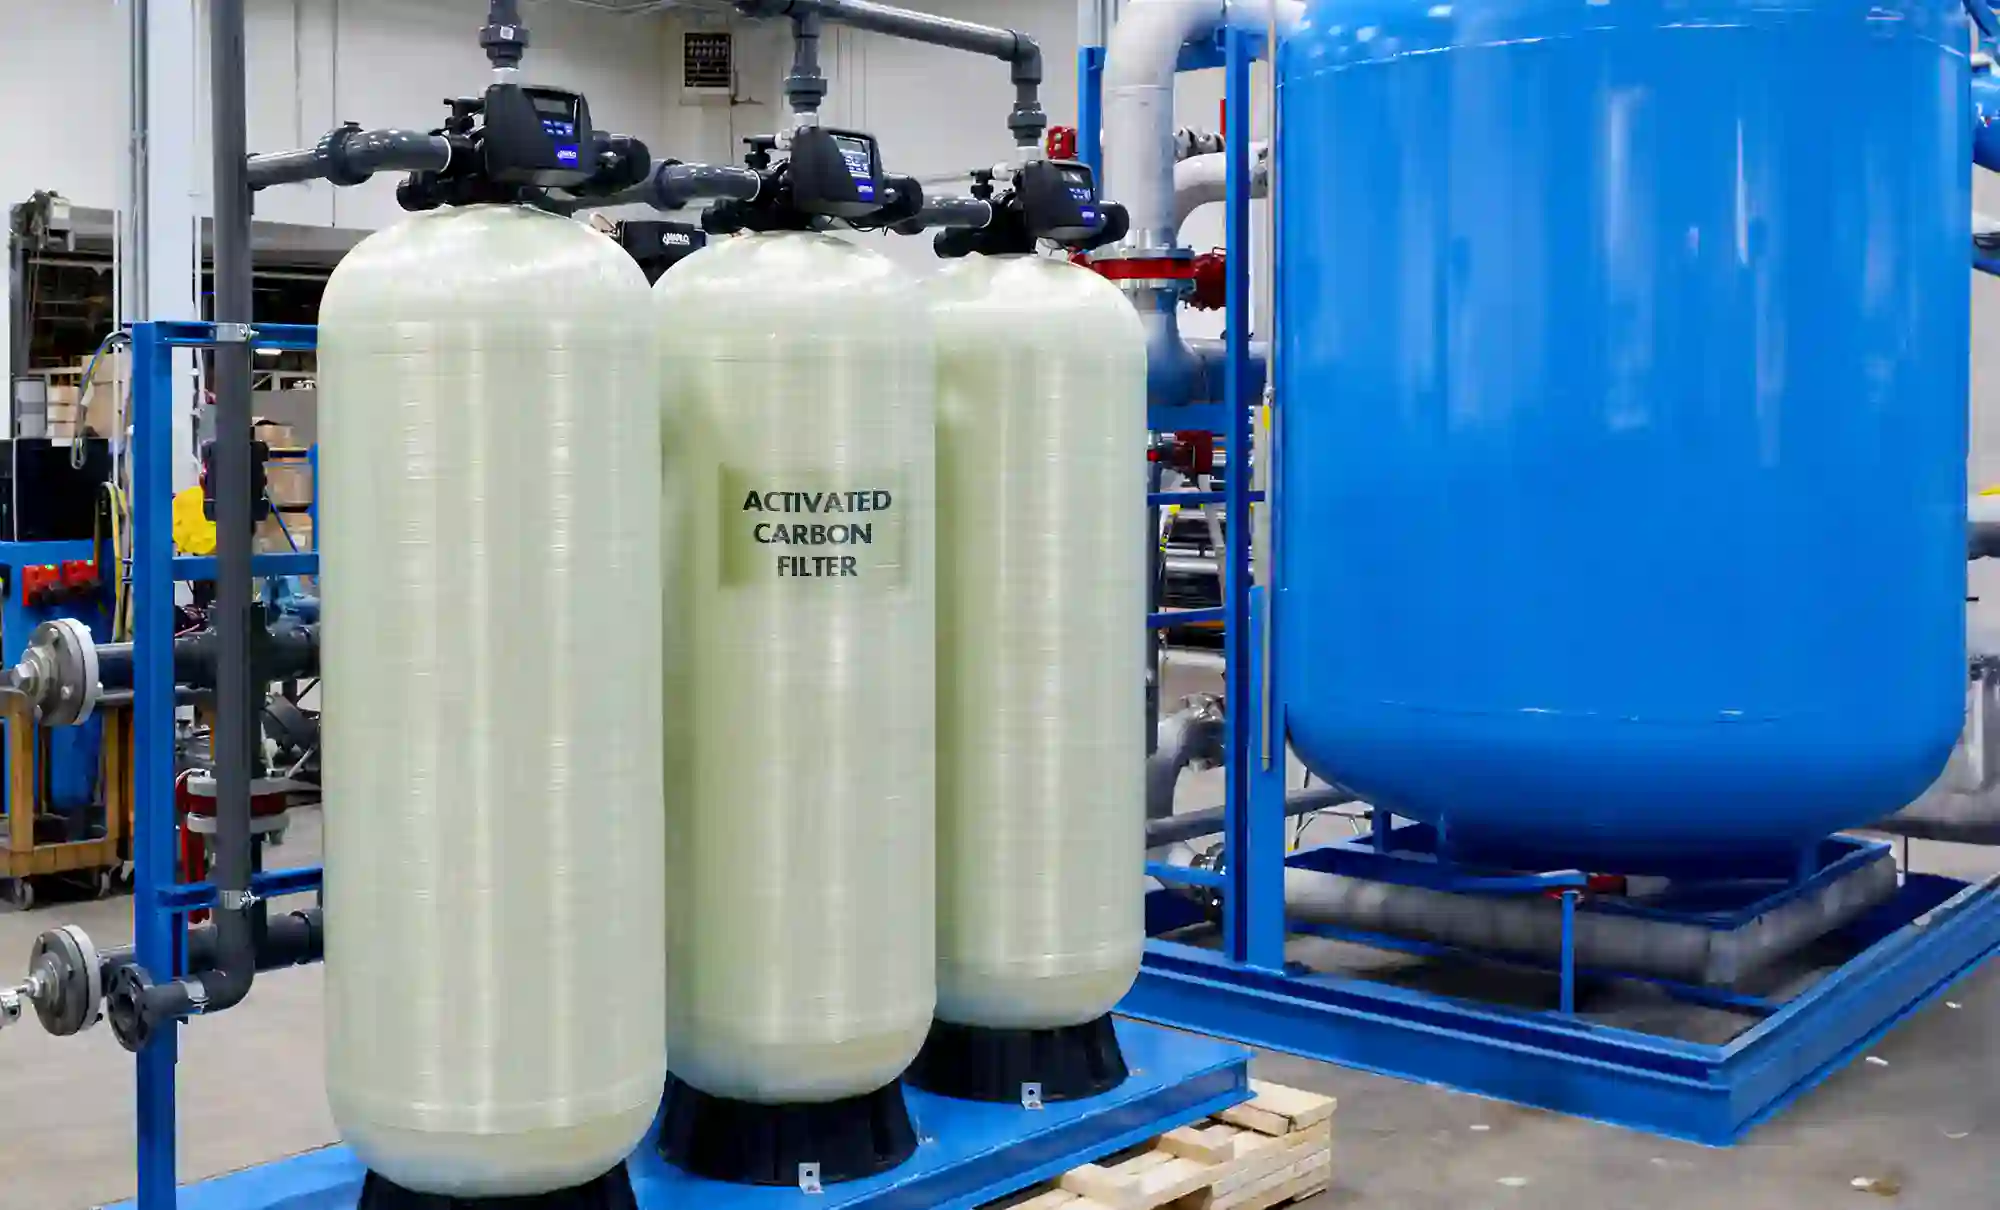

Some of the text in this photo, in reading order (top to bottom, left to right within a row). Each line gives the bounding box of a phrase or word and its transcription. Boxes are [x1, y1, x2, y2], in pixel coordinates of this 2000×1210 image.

[743, 490, 892, 513] ACTIVATED
[753, 523, 872, 545] CARBON
[777, 555, 858, 577] FILTER
